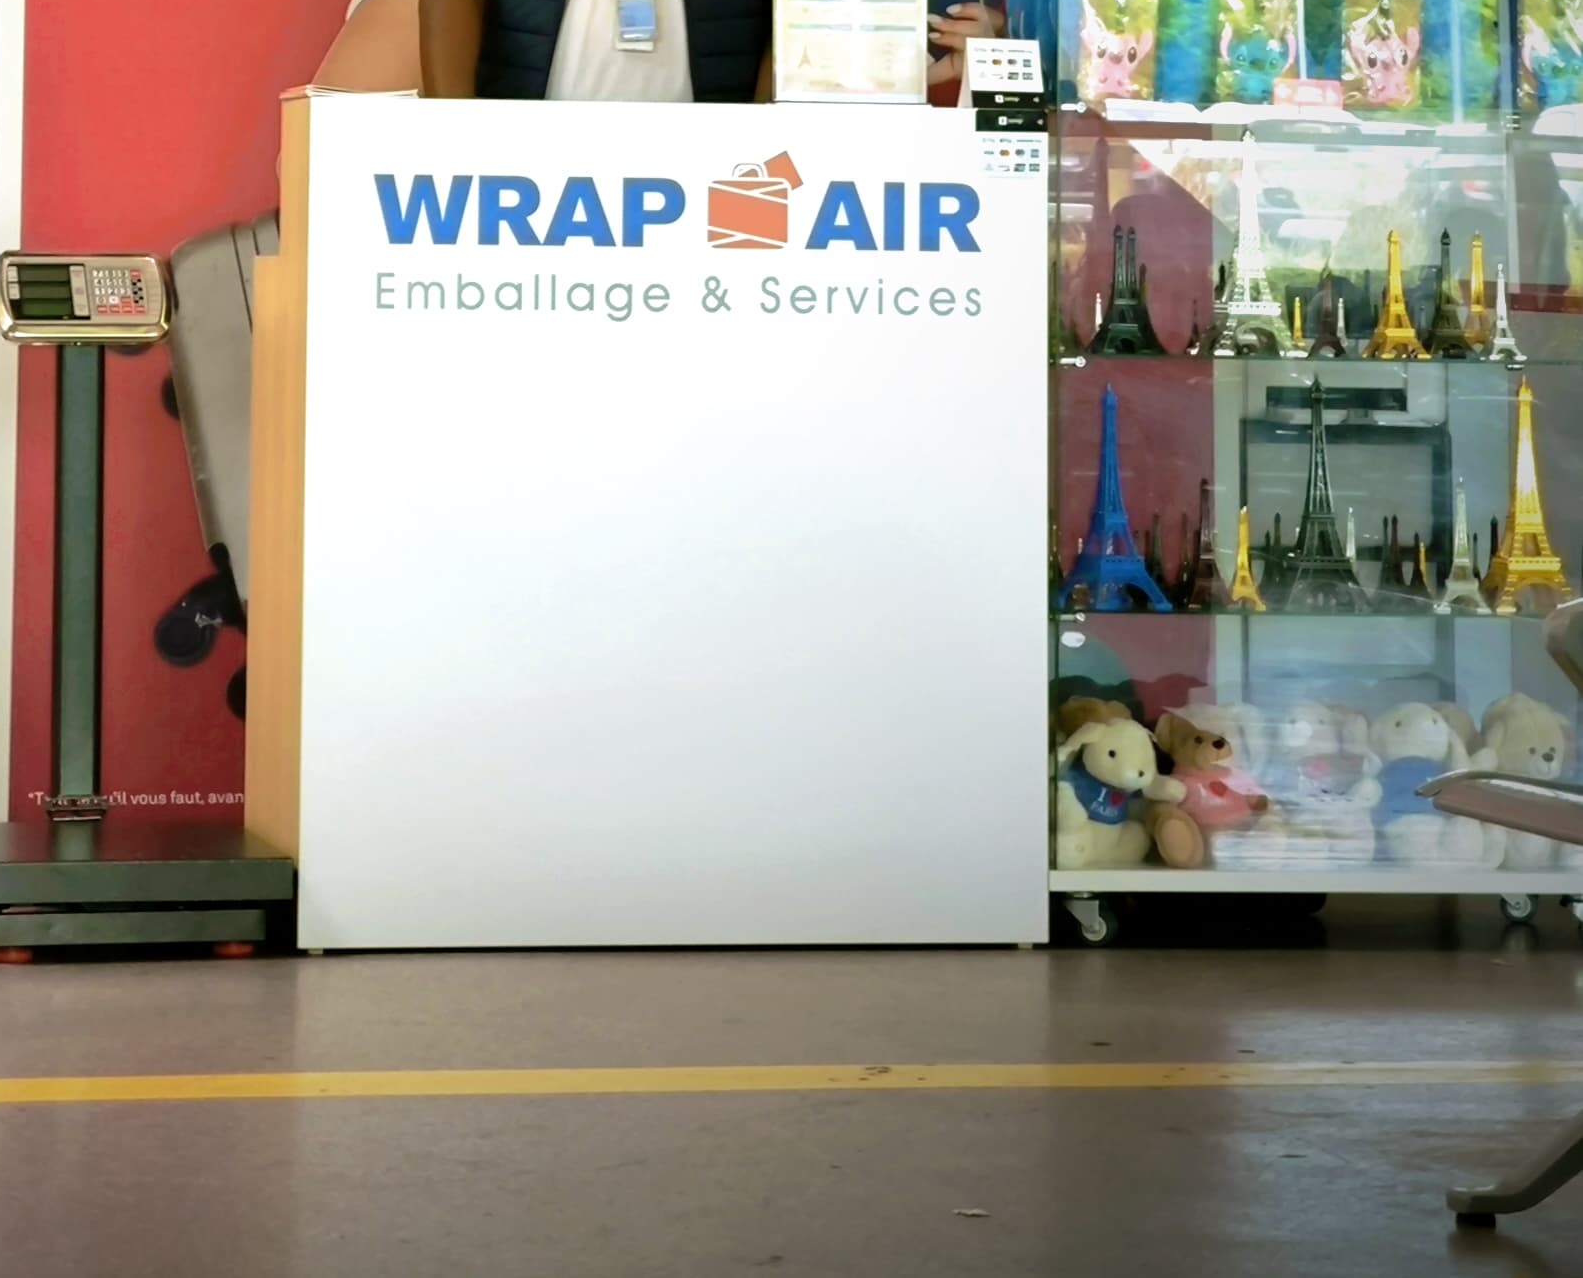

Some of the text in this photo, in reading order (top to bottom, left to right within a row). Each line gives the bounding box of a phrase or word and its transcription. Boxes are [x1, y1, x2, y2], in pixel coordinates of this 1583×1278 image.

[373, 174, 982, 252] WRAP AIR
[376, 272, 982, 322] Emballage & Services
[132, 793, 166, 805] vous
[170, 791, 204, 806] faut,
